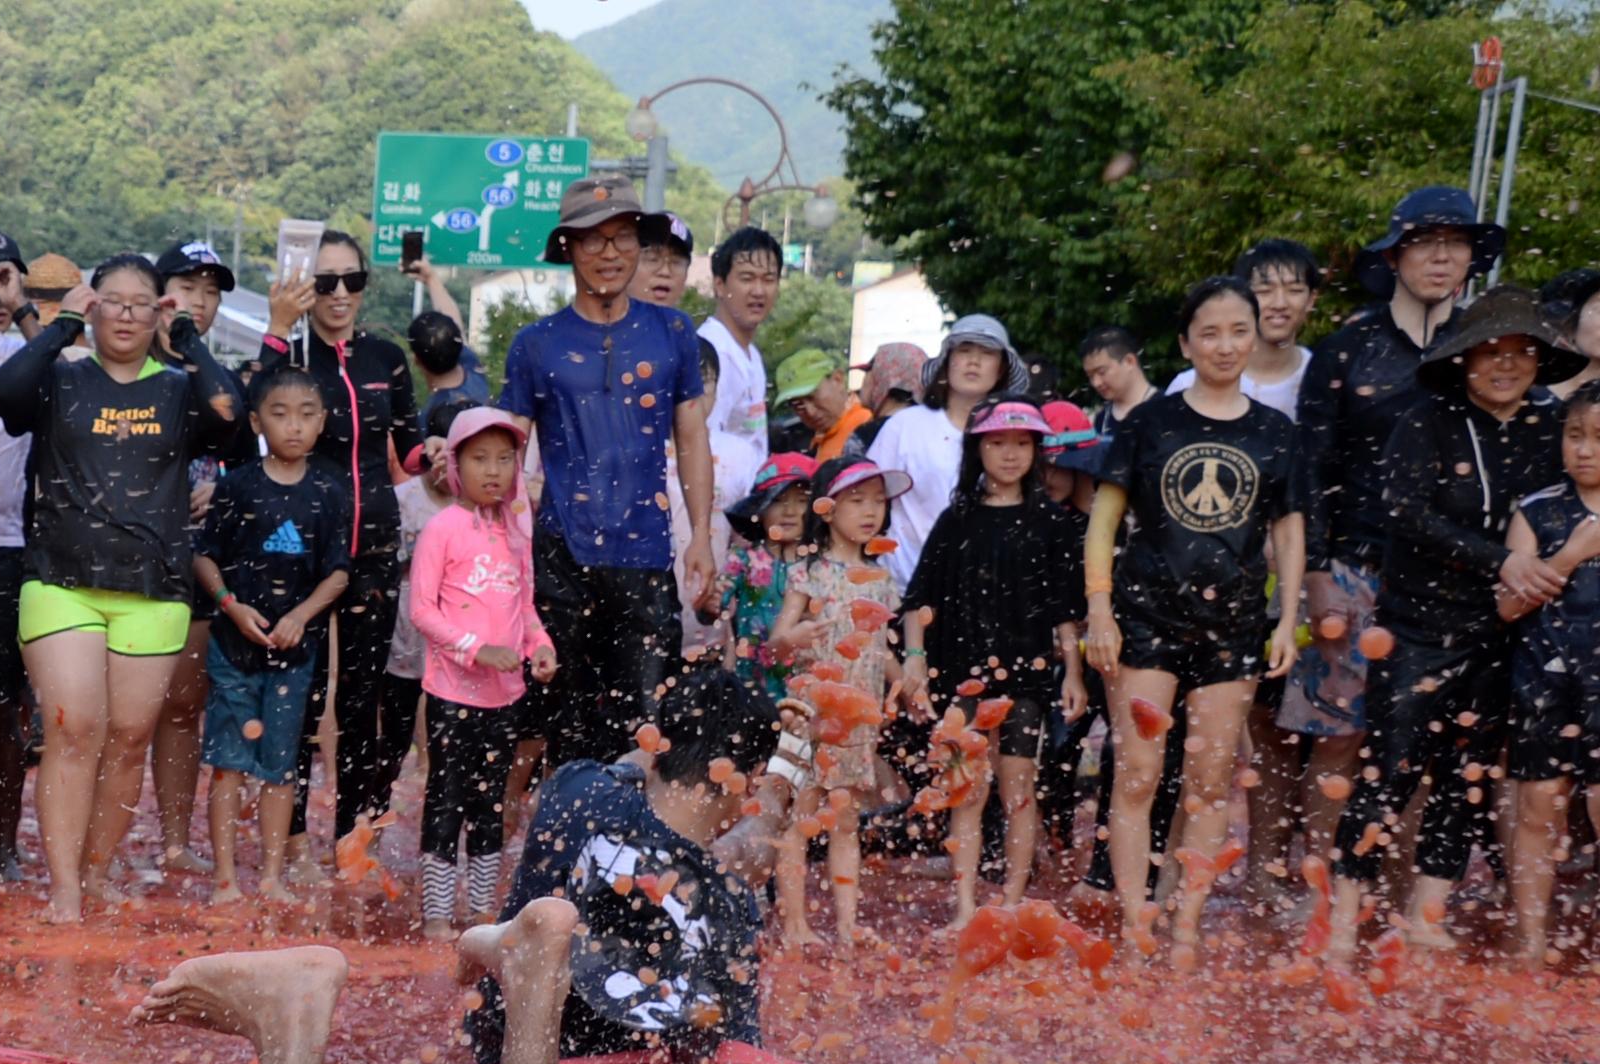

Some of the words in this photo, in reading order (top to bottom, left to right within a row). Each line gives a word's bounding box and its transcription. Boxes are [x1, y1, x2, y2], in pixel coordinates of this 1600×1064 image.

[499, 146, 511, 161] 5
[526, 143, 564, 163] 춘천
[525, 163, 583, 174] Chuncheon
[489, 189, 510, 203] 56
[524, 180, 562, 199] 화천
[524, 201, 561, 211] Hwach
[451, 213, 472, 227] 56
[467, 252, 502, 264] 200m
[101, 406, 156, 420] Hello!
[91, 418, 162, 435] Brwn
[262, 540, 304, 554] adida
